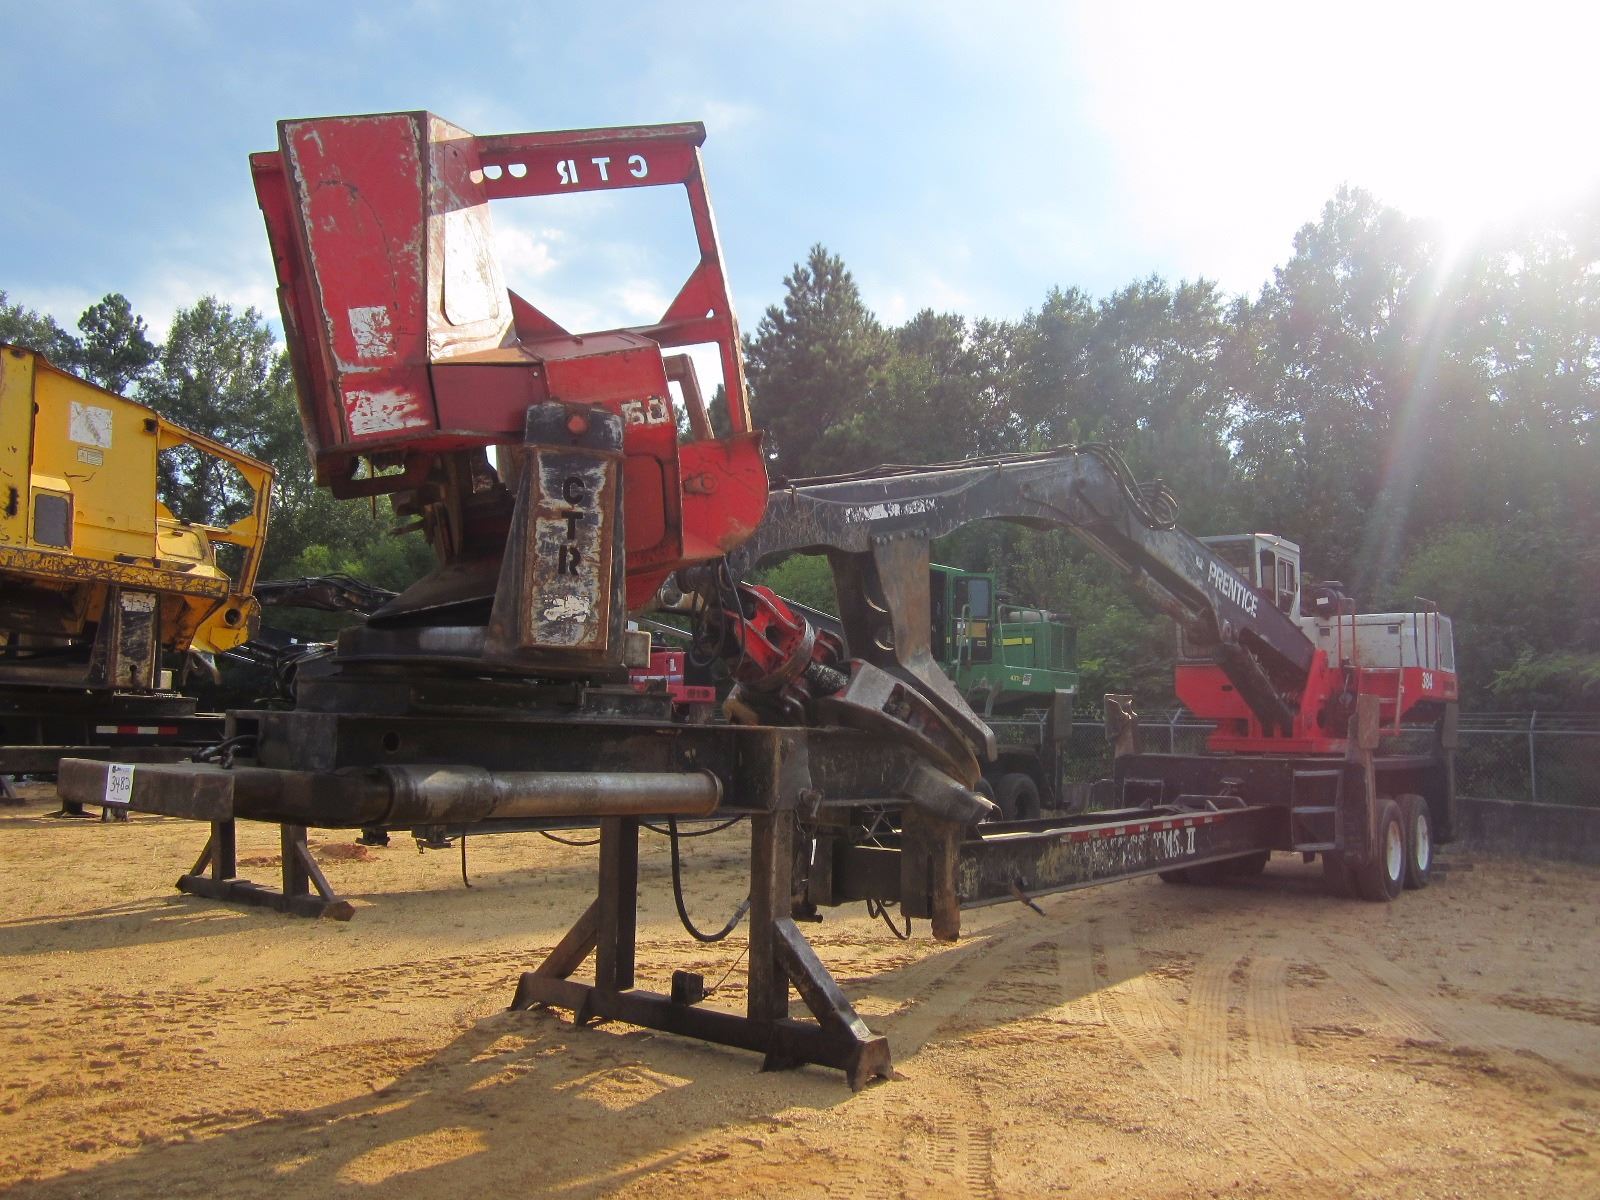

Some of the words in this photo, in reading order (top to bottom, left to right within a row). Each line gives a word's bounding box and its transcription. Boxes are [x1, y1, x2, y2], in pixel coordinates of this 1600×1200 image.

[558, 476, 585, 576] CTR
[1207, 560, 1259, 618] PRENTICE
[1421, 671, 1433, 690] 384
[110, 775, 131, 793] 3482
